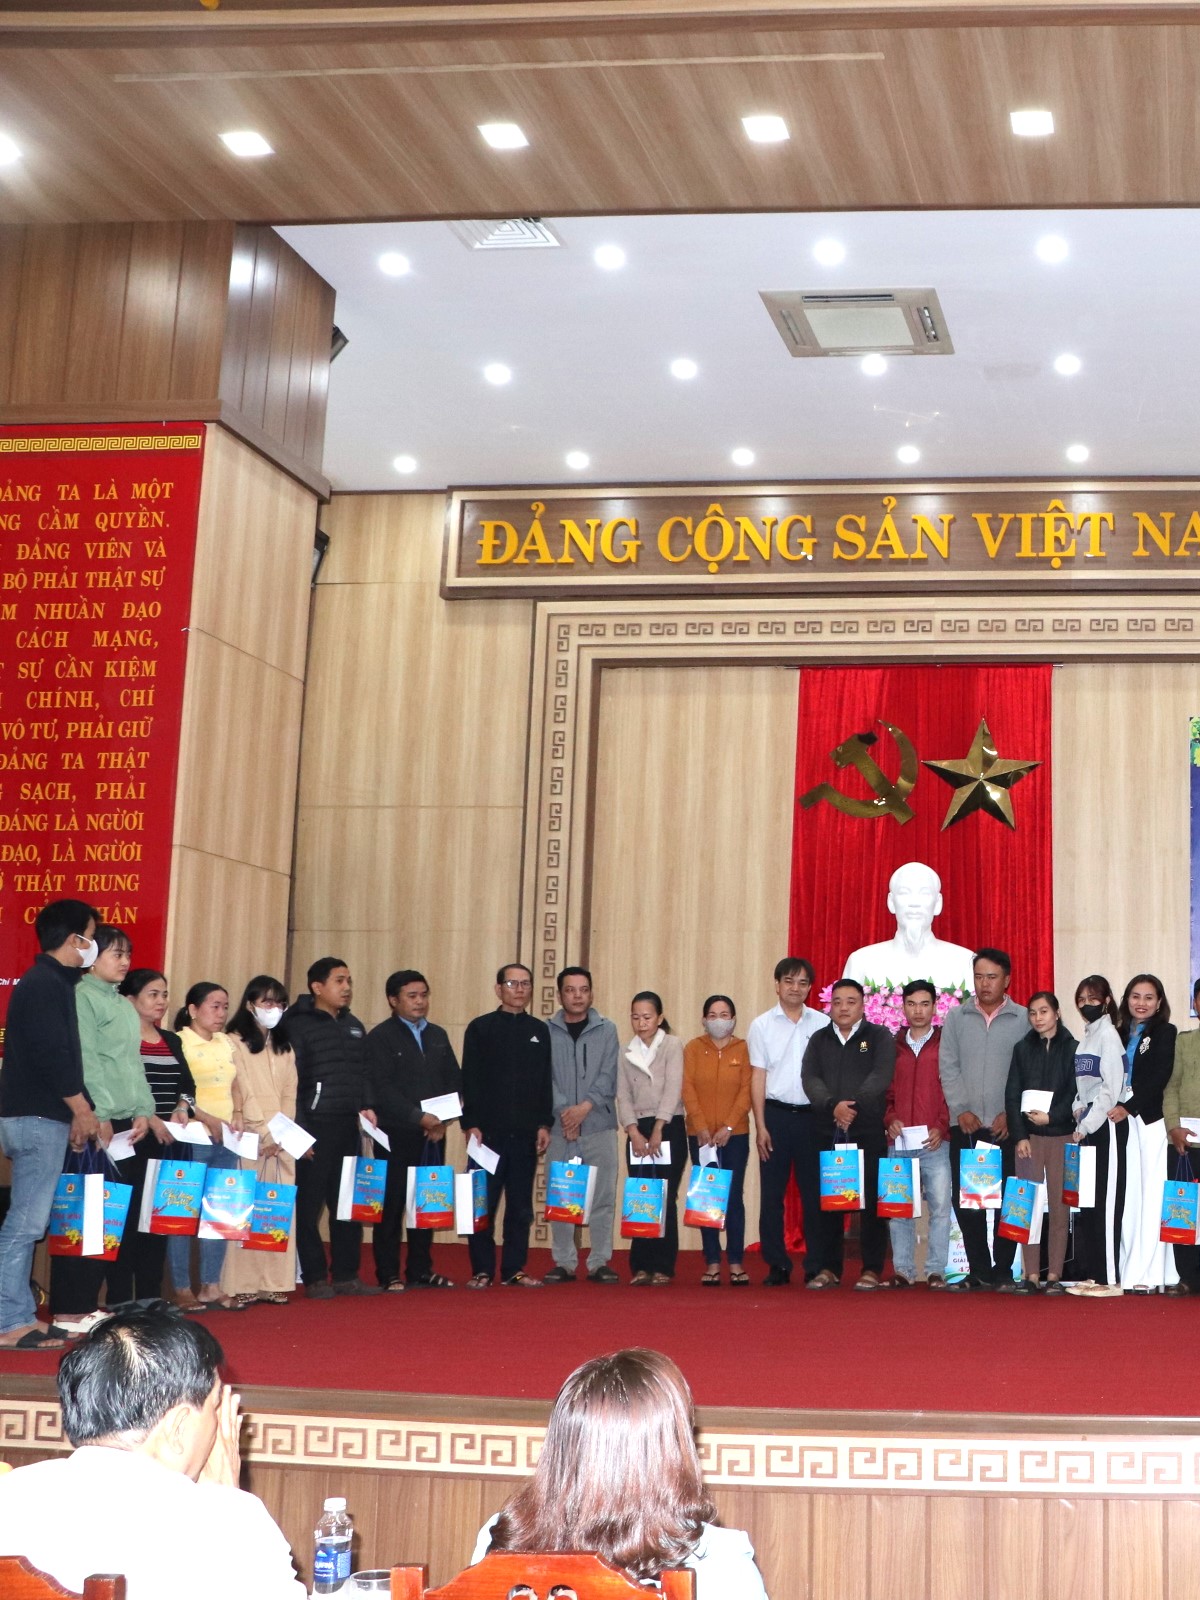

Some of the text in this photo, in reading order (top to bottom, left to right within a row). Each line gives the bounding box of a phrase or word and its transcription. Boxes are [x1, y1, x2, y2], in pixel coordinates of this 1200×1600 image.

[0, 478, 174, 505] ẢNG TA LÀ MỘT
[38, 506, 79, 530] CẦM
[95, 501, 169, 532] QUYỀN.
[16, 537, 70, 560] ĐẢNG
[84, 537, 133, 558] VIÊN
[144, 536, 166, 557] VÀ
[476, 502, 641, 564] ĐẢNG
[657, 504, 816, 574] CỘNG
[833, 496, 954, 560] SẢN
[971, 499, 1114, 569] VIỆT
[2, 566, 166, 593] BỘ PHẢI THẬT SỰ
[34, 595, 105, 619] NHUẦN
[122, 601, 161, 621] ĐẠO
[16, 627, 158, 651] CÁCH MẠNG,
[18, 658, 44, 682] SỰ
[55, 654, 93, 678] CẦN
[104, 656, 157, 681] KIỆM
[27, 687, 99, 710] CHÍNH,
[120, 685, 155, 707] CHÍ
[1, 715, 153, 741] VÔ TƯ, PHẢI GIỮ
[0, 747, 149, 773] ĐẢNG TA THẬT
[20, 782, 76, 804] SẠCH,
[95, 775, 146, 799] PHẢI
[0, 808, 48, 831] ĐÁNG
[54, 808, 79, 830] LÀ
[0, 844, 41, 866] ĐẠO,
[52, 838, 76, 861] LÀ
[14, 869, 65, 896] THẬT
[76, 874, 140, 892] TRUNG
[97, 903, 138, 924] HÂN
